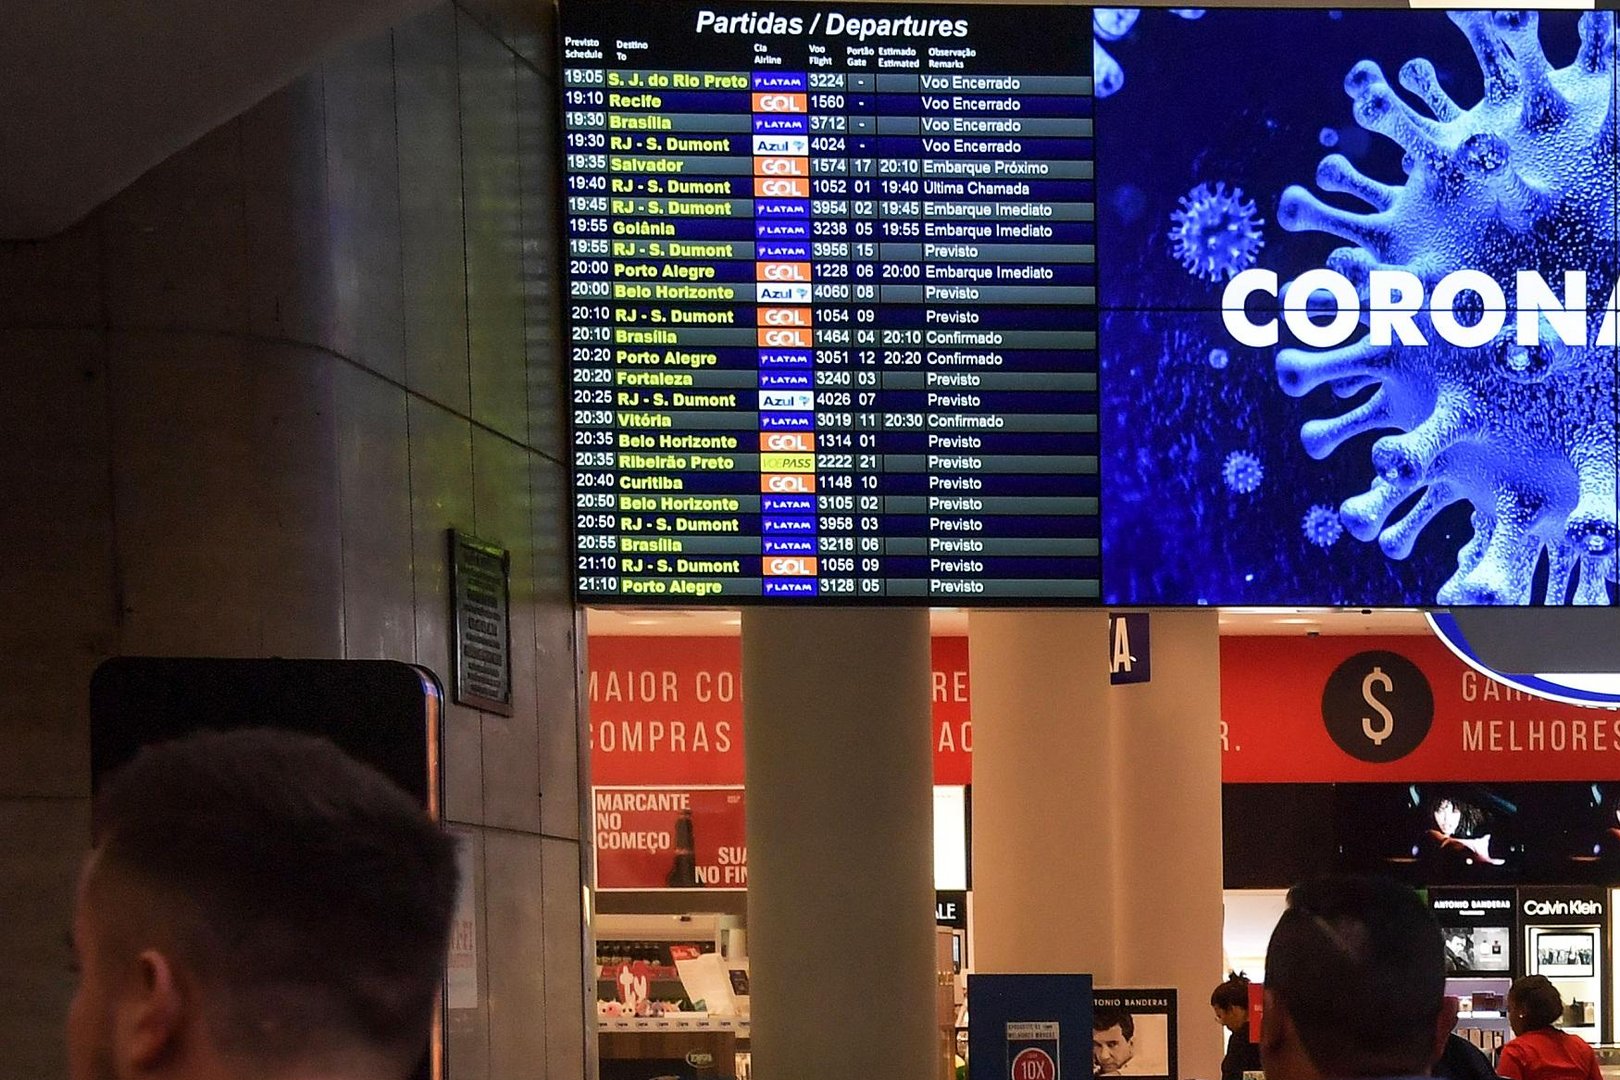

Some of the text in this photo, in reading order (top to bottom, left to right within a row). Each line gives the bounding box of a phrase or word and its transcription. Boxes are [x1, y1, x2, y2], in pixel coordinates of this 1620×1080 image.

[696, 10, 969, 42] Partidas / Departures
[565, 37, 599, 47] Previsto
[616, 40, 648, 49] Destino
[809, 44, 825, 53] Voo
[565, 50, 602, 59] Schedule
[617, 52, 627, 61] To
[878, 47, 916, 56] Estimado
[929, 48, 976, 58] Observação
[754, 56, 781, 65] Airline
[809, 57, 832, 66] Flight
[847, 58, 867, 67] Gate
[878, 58, 920, 68] Estimated
[929, 59, 964, 69] Remarks
[565, 90, 1021, 113] 19:10 Recife GOL 1560 Voo Encerrado
[567, 154, 1049, 177] 19:35 Salvador GOL 1574 17 20:10 Embarque Próximo
[570, 218, 1053, 240] 19:55 Goiânia LATAM 3238 05 19:55 Embarque Imediato
[572, 326, 1003, 347] 20:10 Brasília GOL 1464 04 20:10 Confirmado
[574, 410, 613, 424] 20:30
[617, 412, 672, 428] Vitória
[817, 412, 852, 427] 3019
[859, 413, 875, 427] 11
[884, 413, 923, 427] 20:30
[927, 413, 1004, 428] Confirmado
[578, 576, 984, 596] 21:10 Porto Alegre LATAM 3128 05 Previsto
[589, 721, 730, 752] OMPRAS
[597, 794, 691, 811] MARCANTE
[597, 813, 621, 830] NO
[598, 832, 670, 854] COMEÇO
[695, 866, 720, 884] NO
[1434, 900, 1511, 909] ANTONIO BANDERAS
[1524, 900, 1602, 915] Calvin Klein
[1021, 1061, 1045, 1080] 10X
